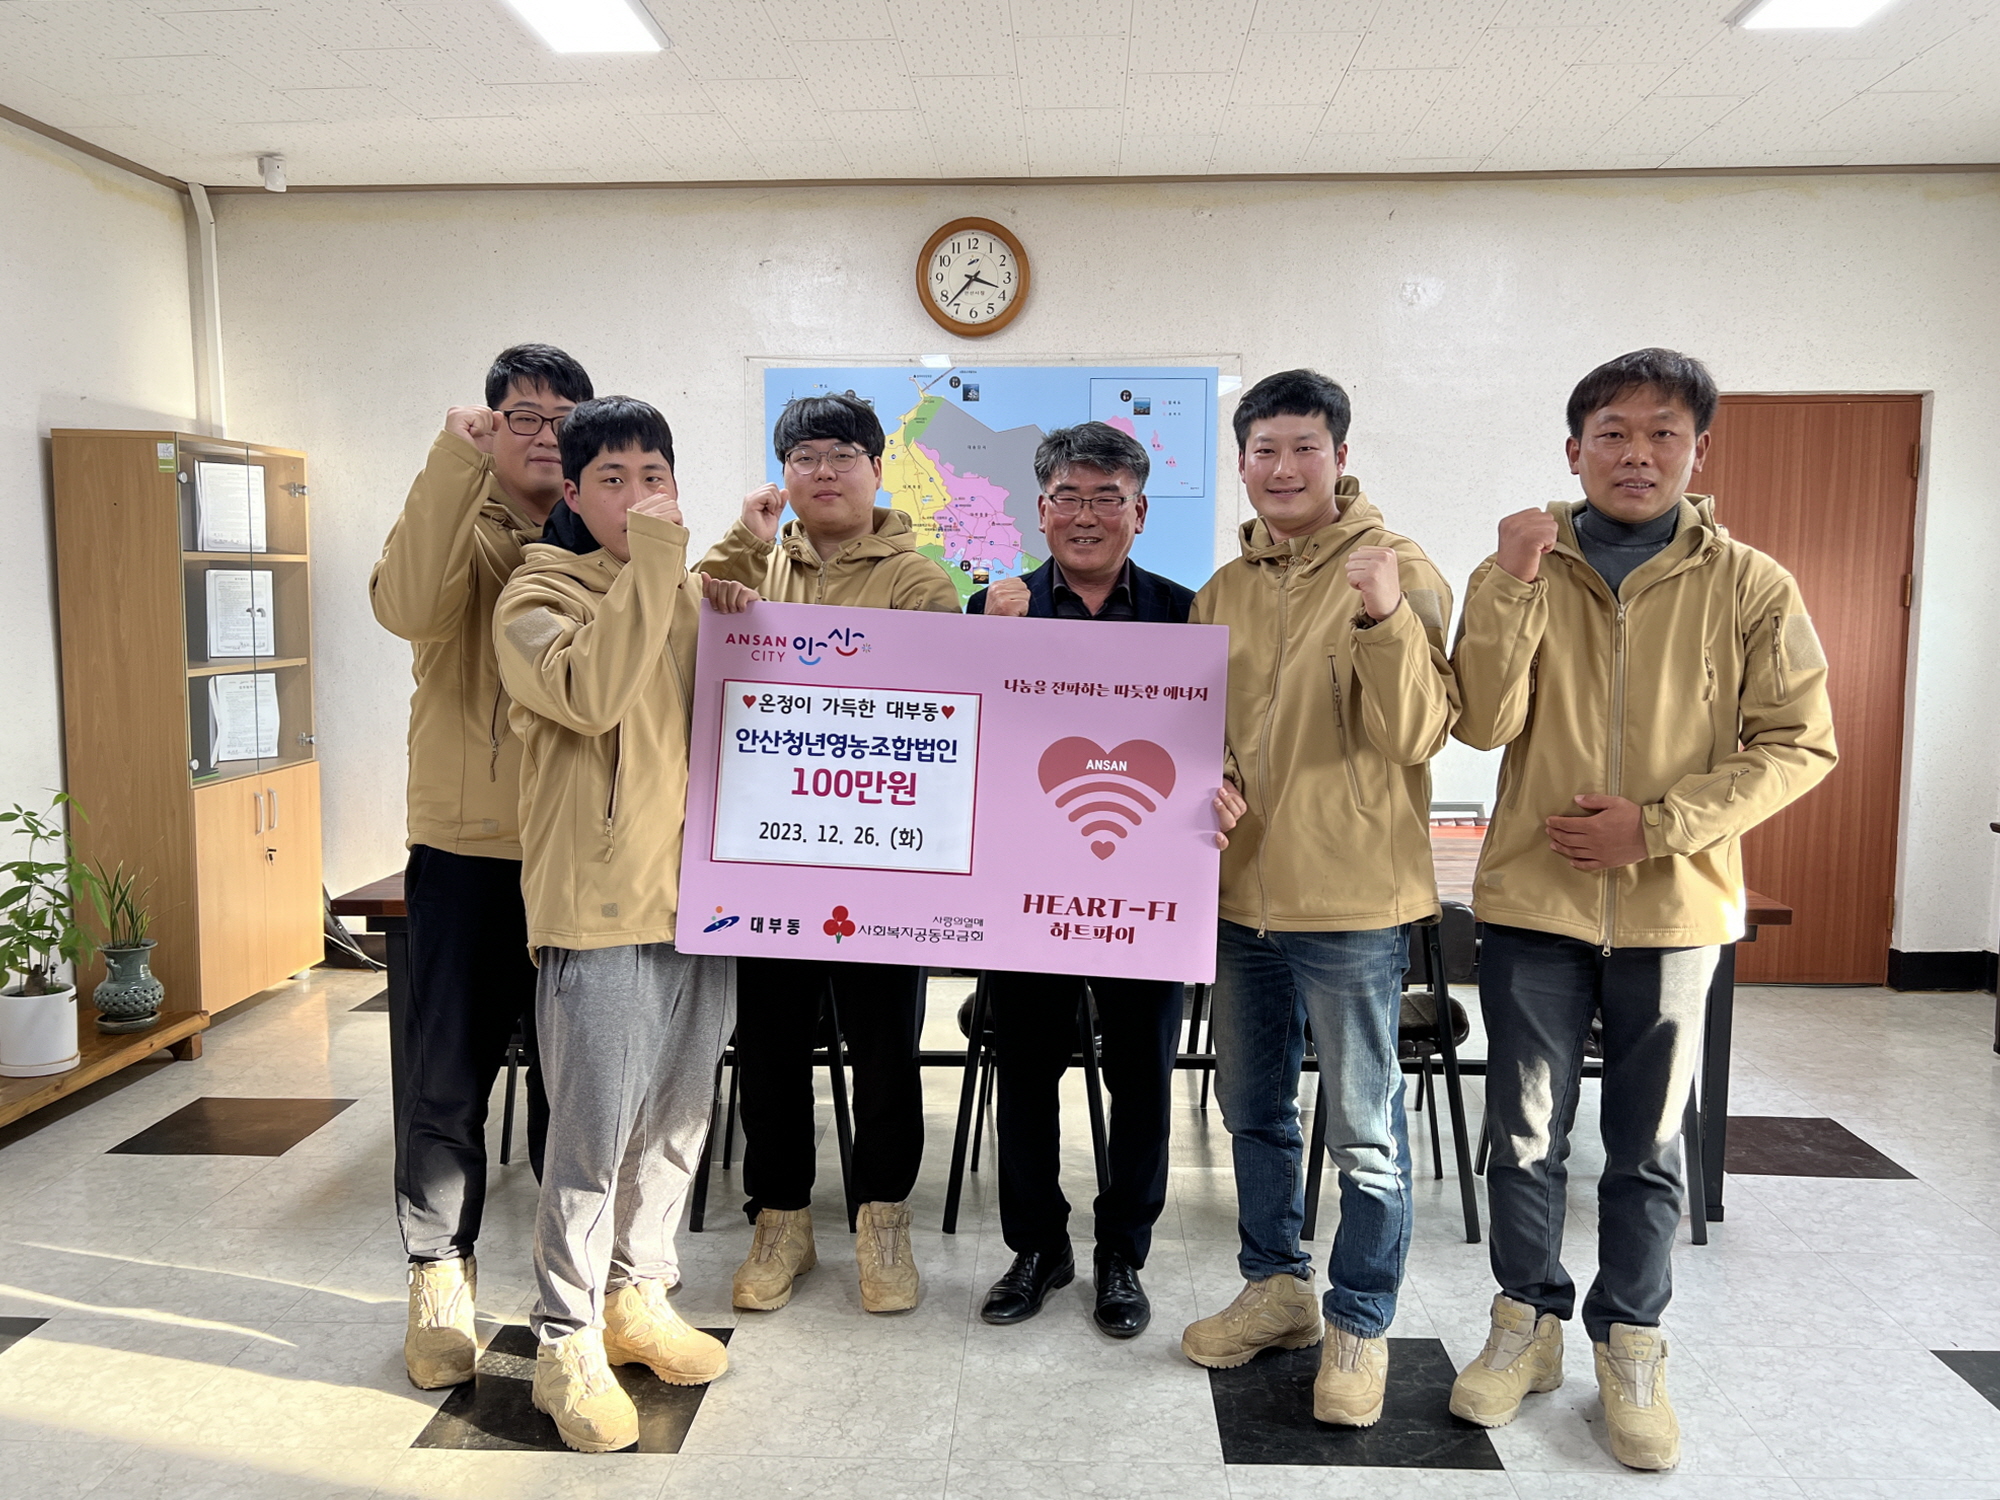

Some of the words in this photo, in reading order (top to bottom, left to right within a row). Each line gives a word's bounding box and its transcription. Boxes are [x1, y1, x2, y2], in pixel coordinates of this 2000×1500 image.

[952, 242, 960, 254] 11
[968, 238, 979, 249] 12
[939, 255, 951, 267] 10
[999, 255, 1006, 267] 2
[935, 272, 944, 284] 9
[1003, 271, 1011, 284] 3
[940, 290, 949, 302] 8
[998, 290, 1006, 301] 4
[954, 303, 961, 315] 7
[969, 307, 978, 319] 6
[986, 303, 995, 314] 5
[725, 633, 787, 648] ANSAN
[793, 627, 865, 666] 안산
[751, 650, 785, 662] CITY
[1003, 678, 1047, 694] 나눔을
[1051, 681, 1110, 698] 전파하는
[1114, 684, 1160, 699] 따듯한
[1163, 685, 1209, 702] 에너지
[758, 693, 812, 715] 온정이
[822, 697, 876, 719] 가득한
[886, 701, 939, 722] 대부동
[735, 728, 958, 764] 안산청년영농조합법인
[1085, 759, 1128, 772] ANSAN
[791, 767, 917, 806] 100만원
[758, 822, 807, 844] 2023.
[817, 825, 844, 845] 12.
[853, 826, 880, 847] 26.
[890, 826, 924, 851] (화)
[1023, 893, 1178, 922] HEART-FI
[749, 915, 801, 936] 대부동
[932, 916, 984, 928] 사랑의열매
[857, 923, 984, 944] 사회복지공동모금회
[1049, 922, 1135, 945] 하트파이
